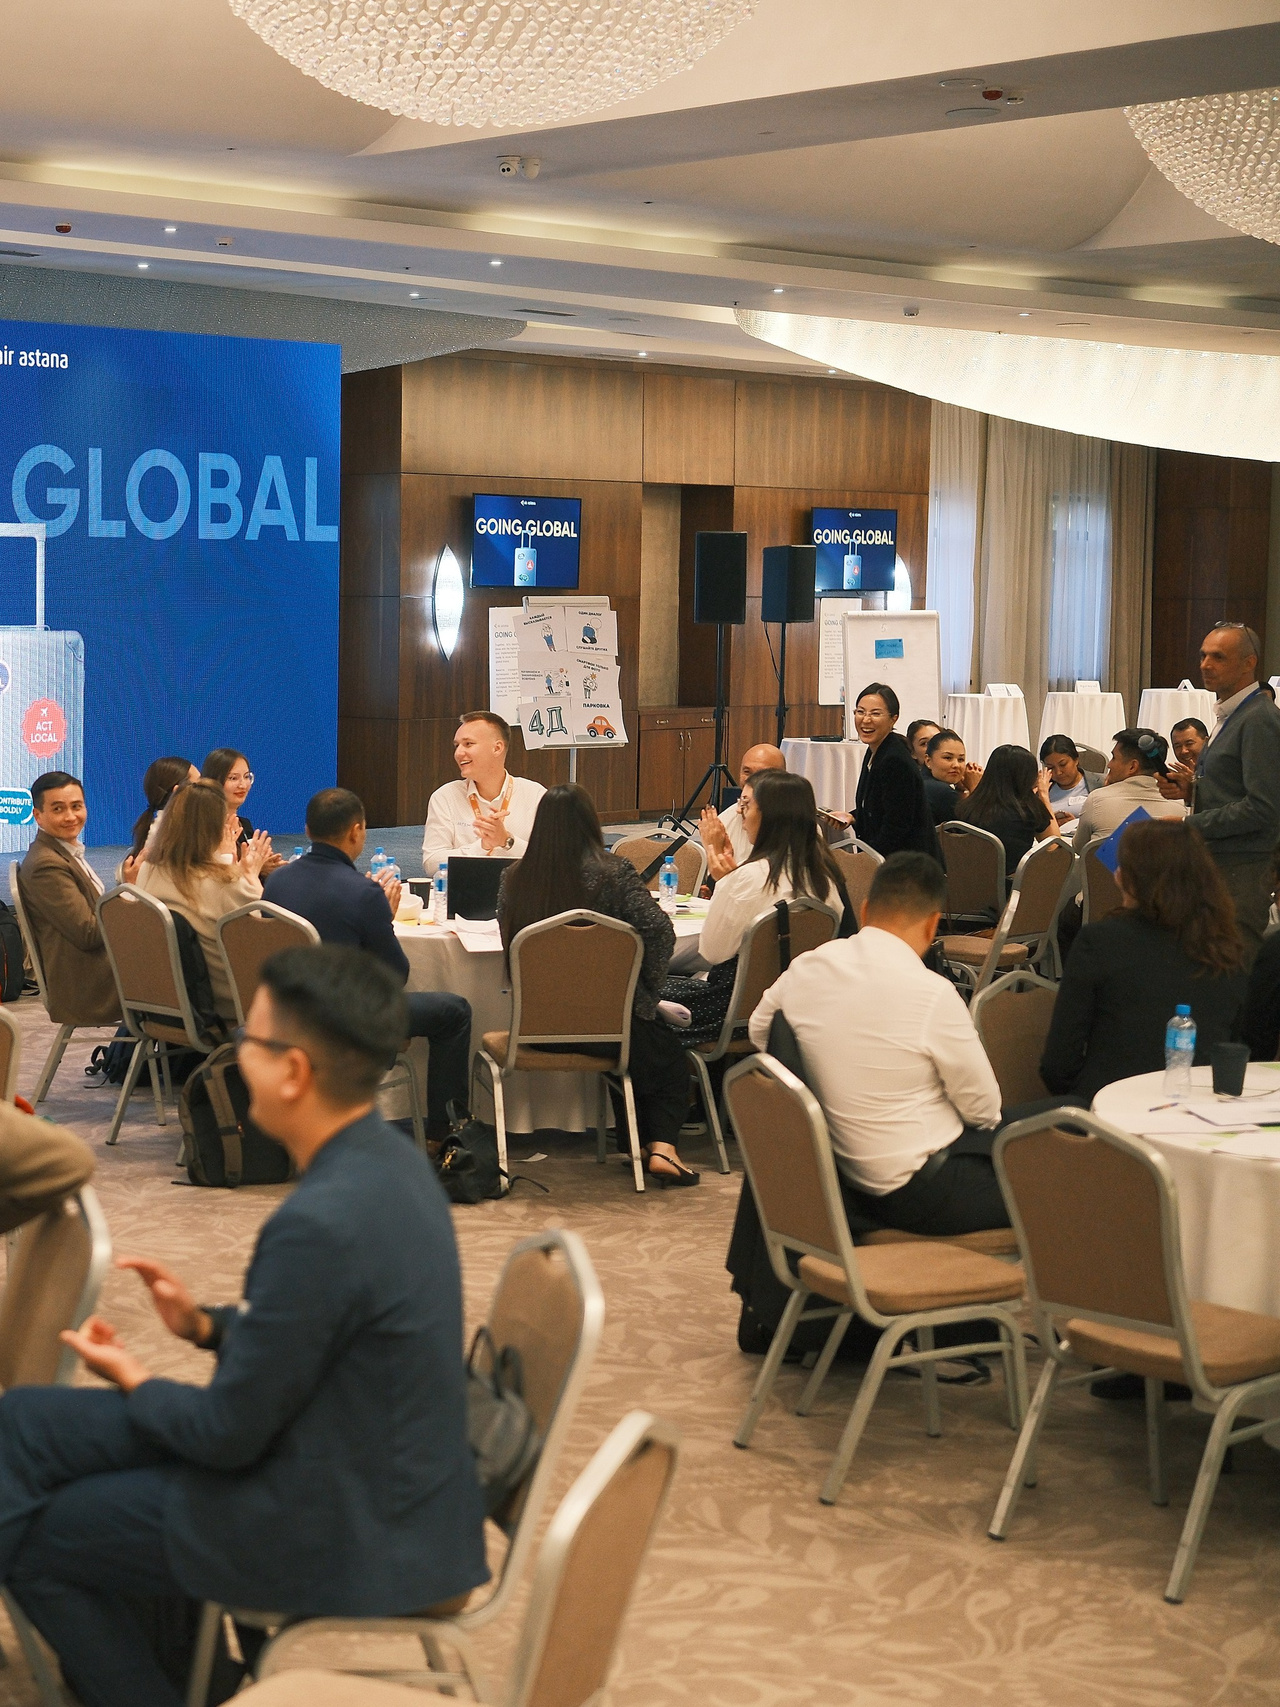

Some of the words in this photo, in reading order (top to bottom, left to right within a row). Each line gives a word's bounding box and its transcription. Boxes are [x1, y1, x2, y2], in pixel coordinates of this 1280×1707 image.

[19, 349, 68, 369] astana
[11, 443, 339, 543] GLOBAL
[476, 517, 522, 536] GOING
[525, 519, 578, 538] GLOBAL
[813, 528, 850, 545] GOING
[852, 529, 894, 545] GLOBAL
[494, 631, 513, 639] GOING
[35, 721, 53, 731] ACT
[30, 732, 58, 743] LOCAL
[0, 805, 23, 814] BOLDLY
